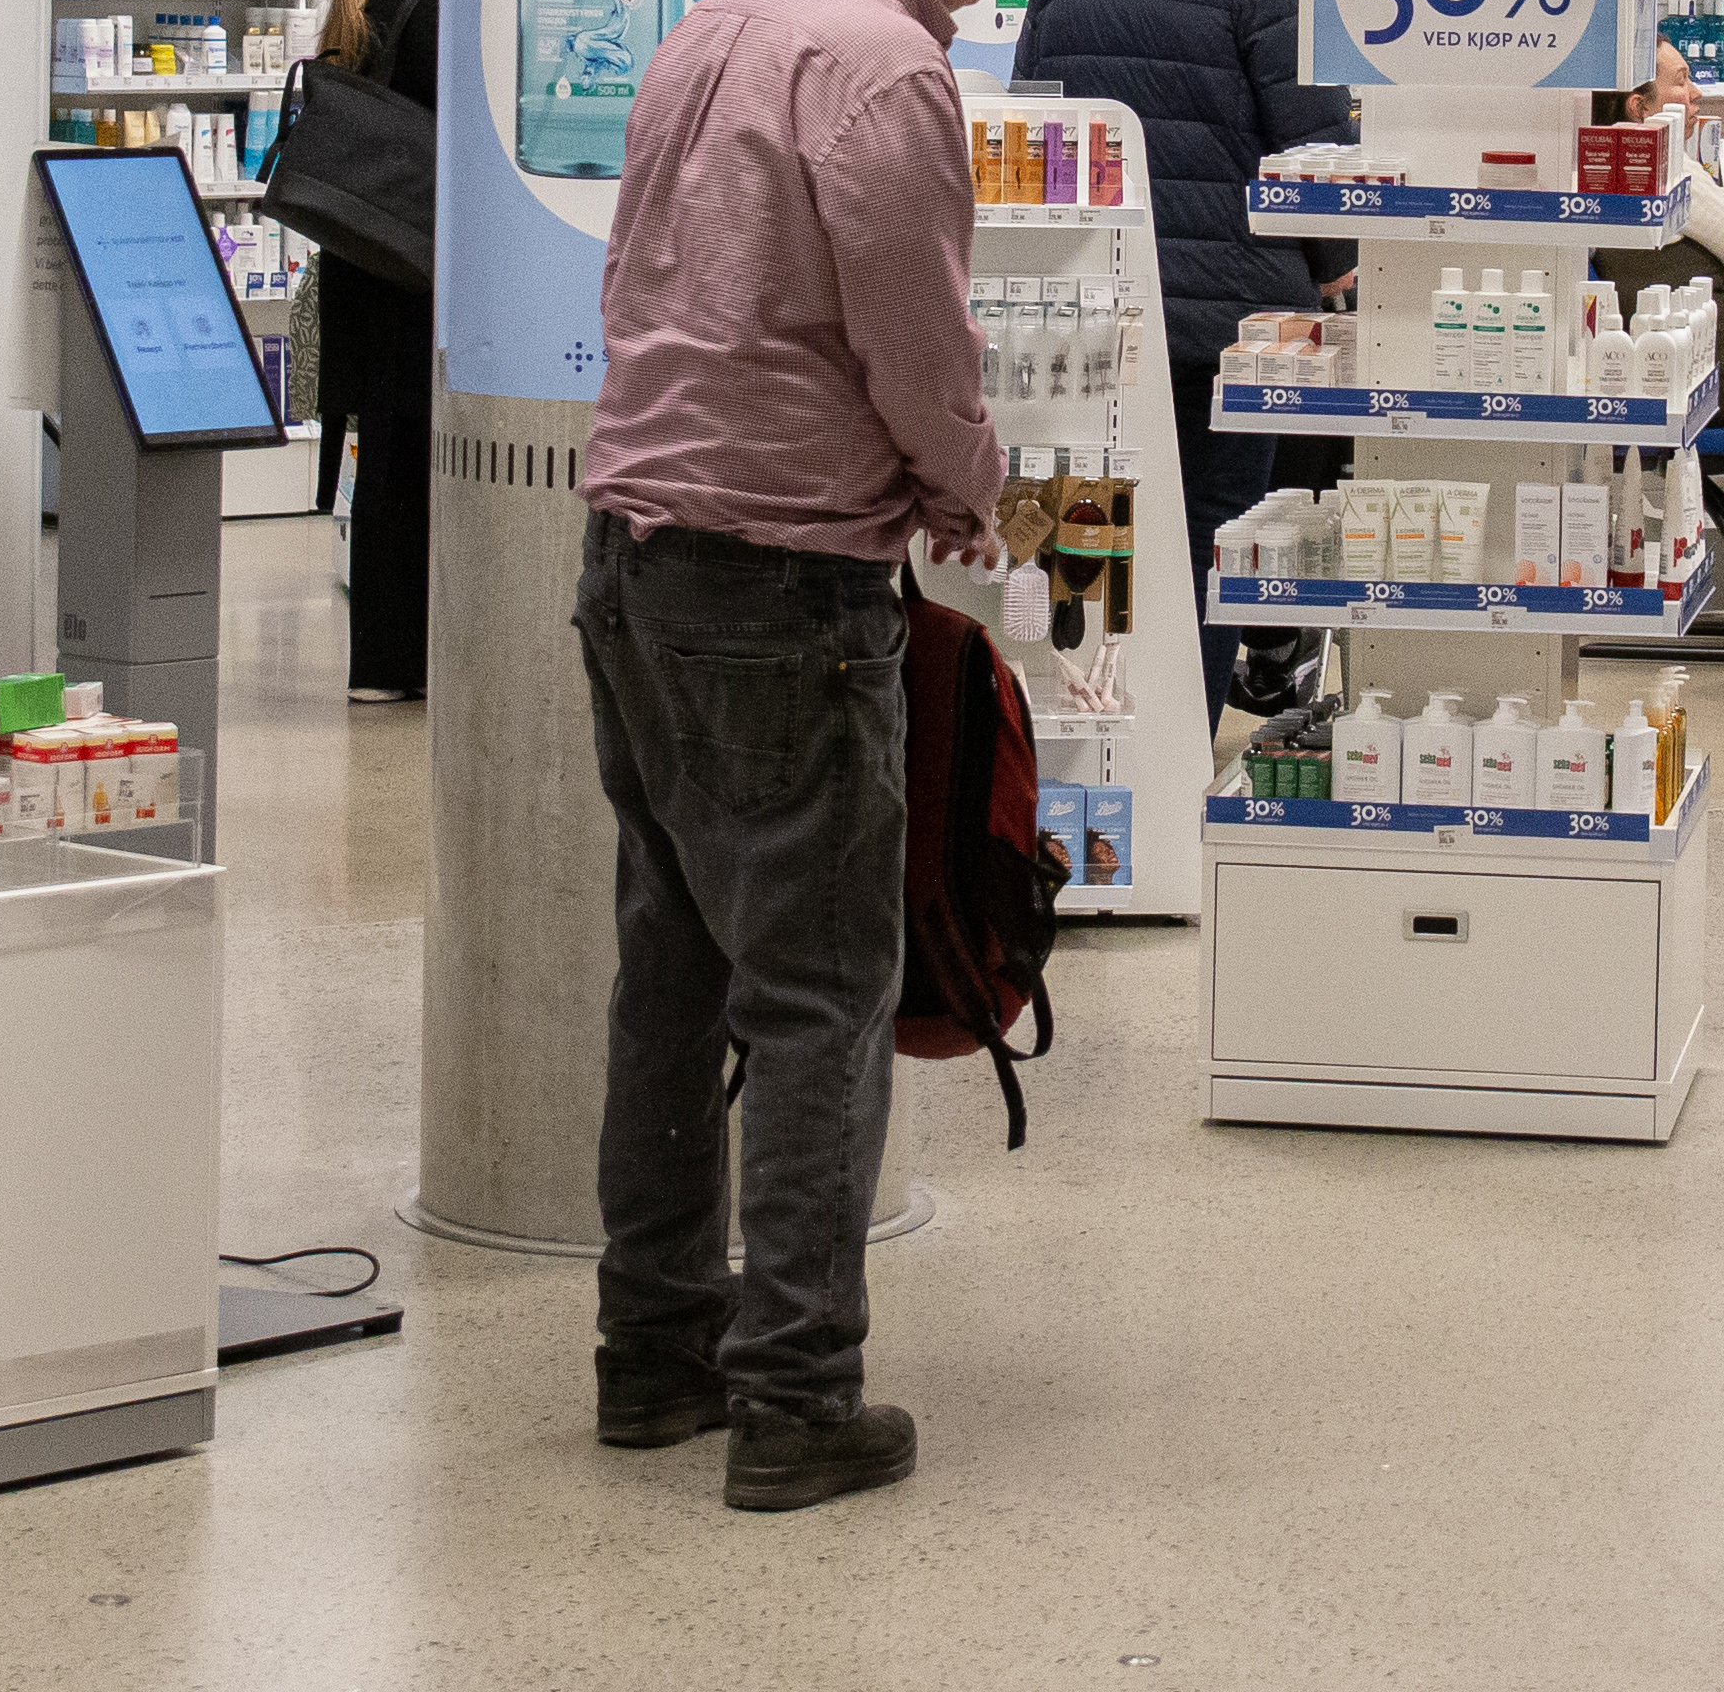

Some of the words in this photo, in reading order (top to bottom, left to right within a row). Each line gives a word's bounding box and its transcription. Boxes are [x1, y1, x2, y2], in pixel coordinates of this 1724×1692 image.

[1423, 31, 1461, 47] VED
[1467, 32, 1513, 51] KJØP
[1518, 33, 1541, 48] AV
[1547, 34, 1557, 48] 2
[1258, 186, 1301, 209] 30%
[1340, 188, 1382, 211] 30%
[1449, 192, 1492, 215] 30%
[1559, 196, 1601, 219] 30%
[1262, 388, 1302, 410] 30%
[1368, 391, 1409, 413] 30%
[1481, 395, 1522, 417] 30%
[1586, 398, 1628, 420] 30%
[1258, 580, 1299, 601] 30%
[1364, 583, 1404, 602] 30%
[1477, 586, 1517, 607] 30%
[1582, 589, 1623, 611] 30%
[1244, 800, 1285, 821] 30%
[1351, 805, 1392, 826] 30%
[1464, 809, 1504, 826] 30%
[1568, 814, 1610, 835] 30%
